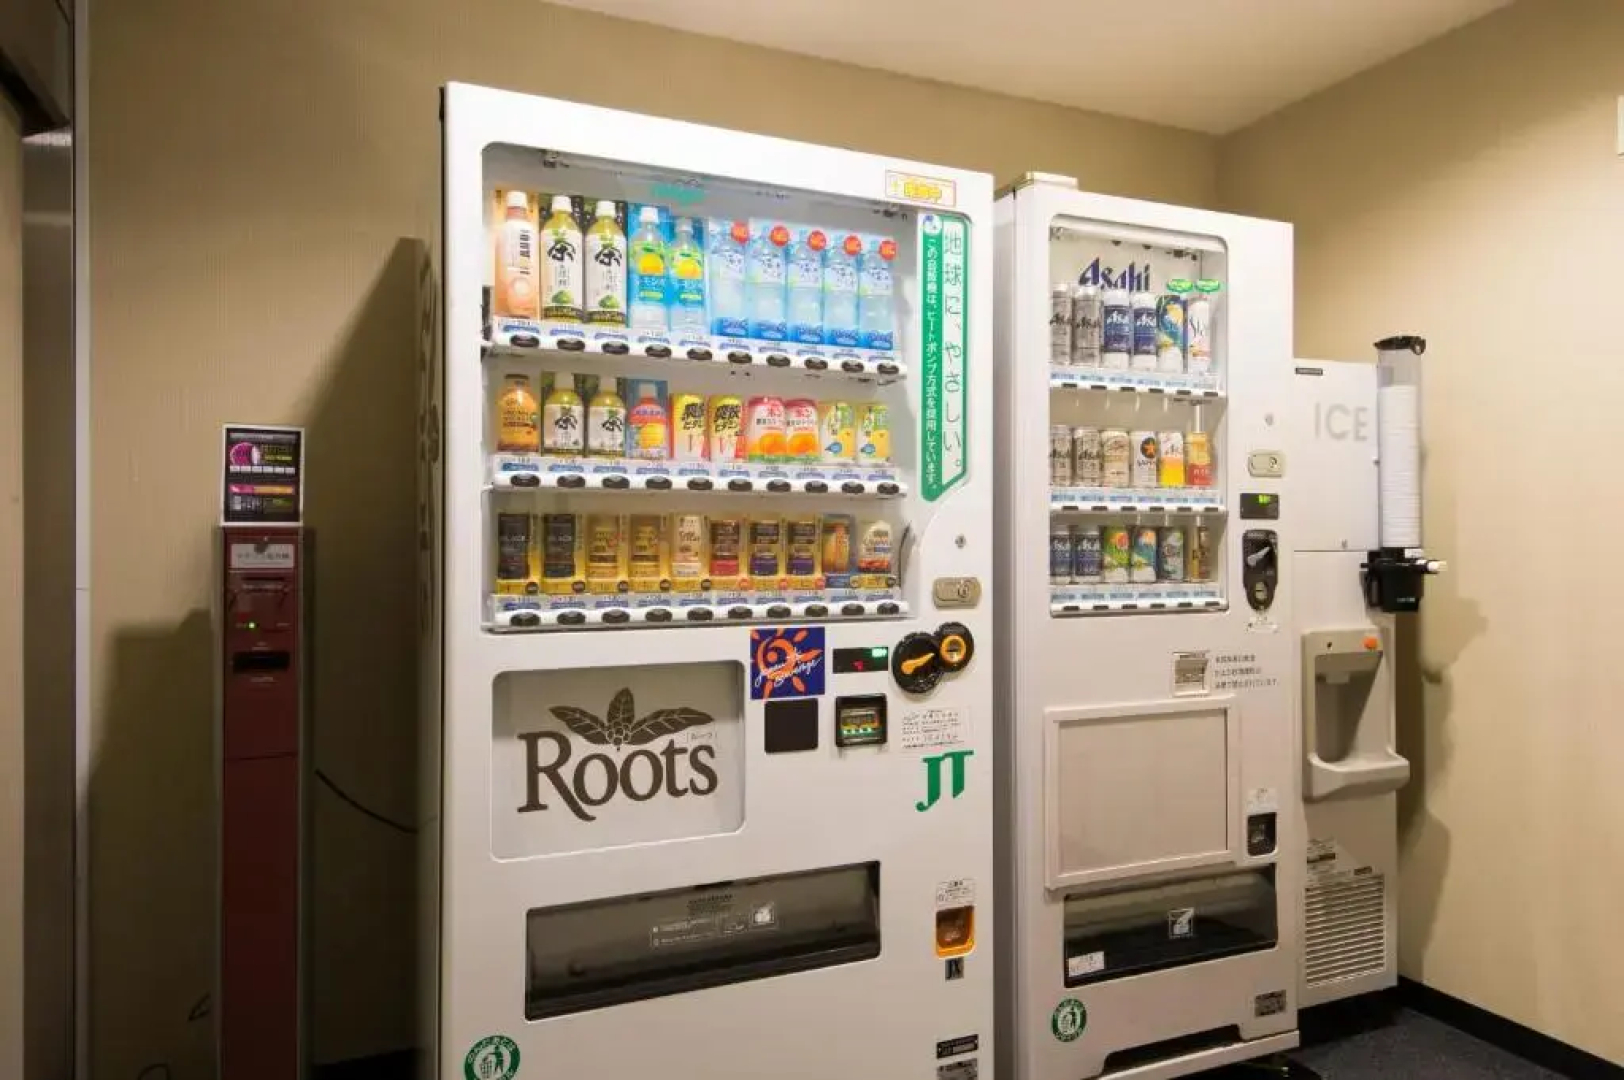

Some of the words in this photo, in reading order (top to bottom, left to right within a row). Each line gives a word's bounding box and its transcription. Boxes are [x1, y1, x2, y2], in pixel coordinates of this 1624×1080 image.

[1077, 256, 1151, 292] Asahi
[942, 228, 963, 468] 地球に、やさしい。
[1314, 402, 1369, 442] ICE
[516, 730, 719, 823] Roots
[915, 749, 974, 812] JT
